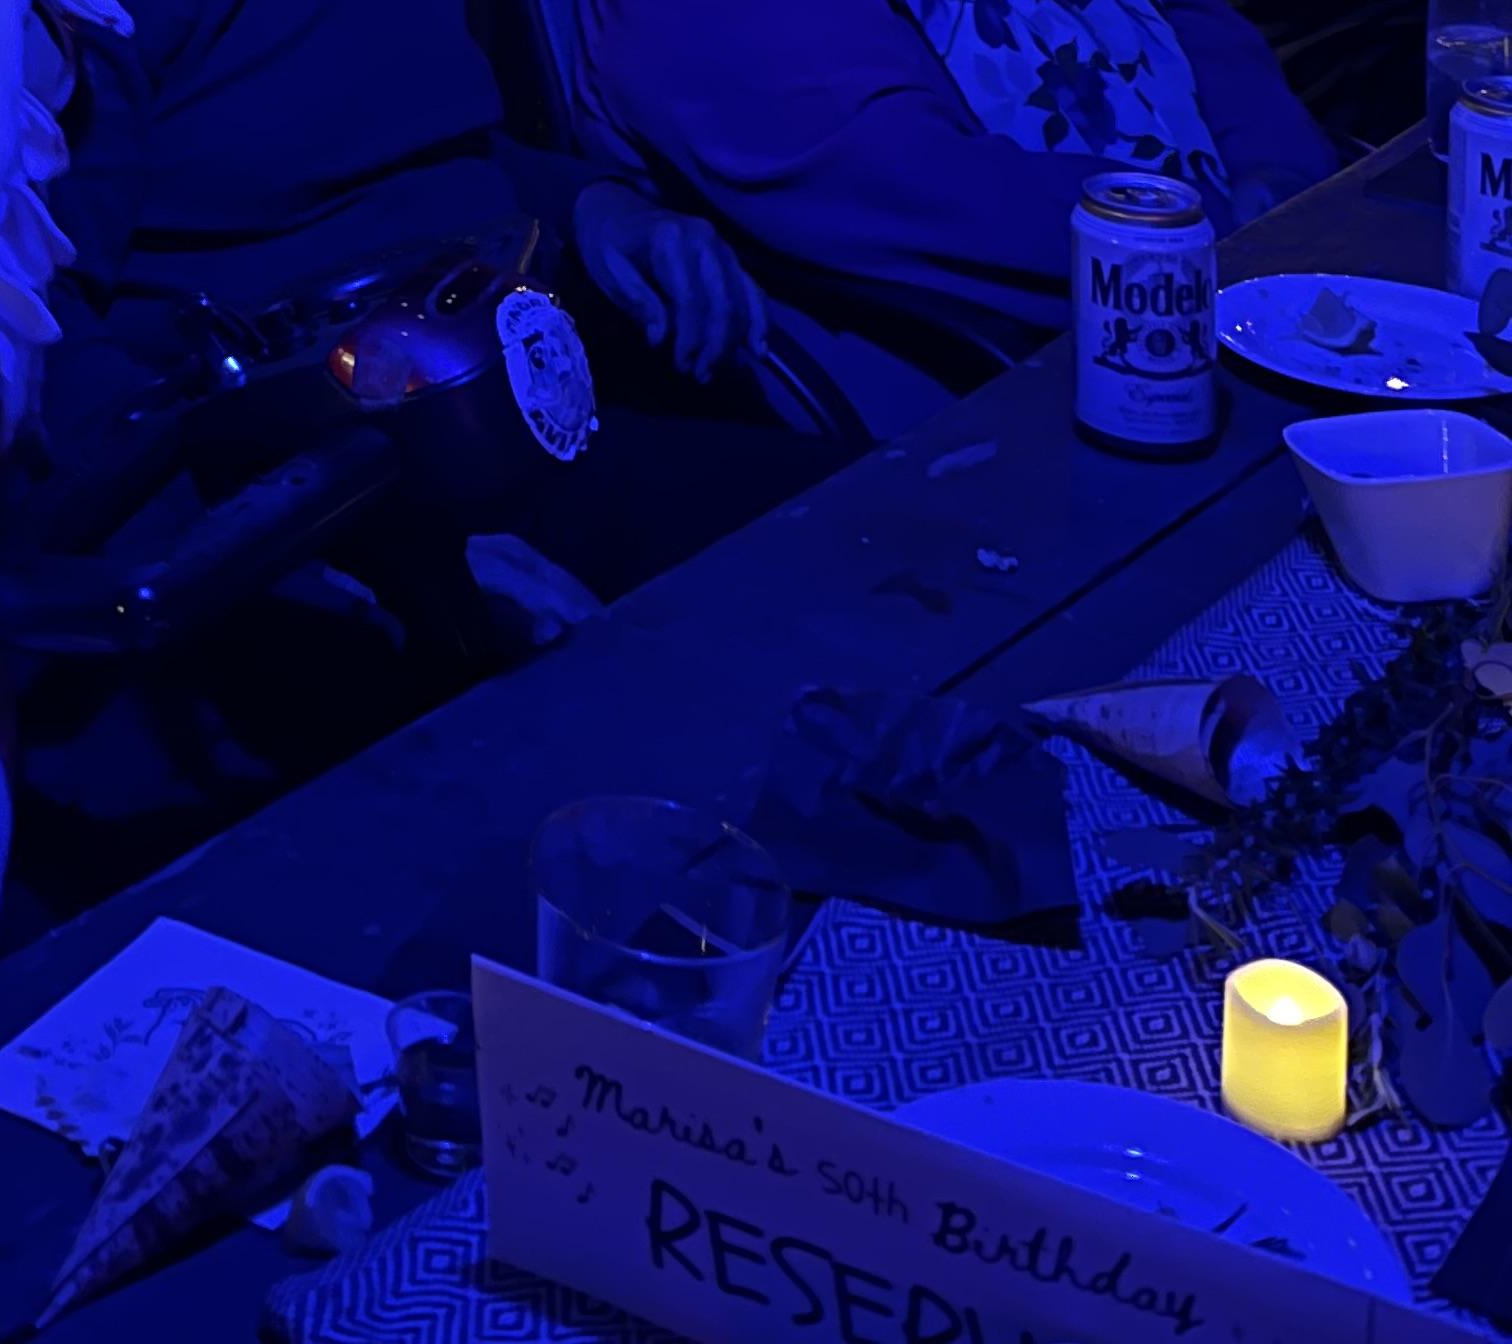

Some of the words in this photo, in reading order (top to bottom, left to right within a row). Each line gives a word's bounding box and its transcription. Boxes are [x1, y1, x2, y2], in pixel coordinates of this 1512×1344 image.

[574, 1065, 799, 1177] Marisa's
[817, 1160, 908, 1223] 50th
[932, 1201, 1204, 1335] Birthday
